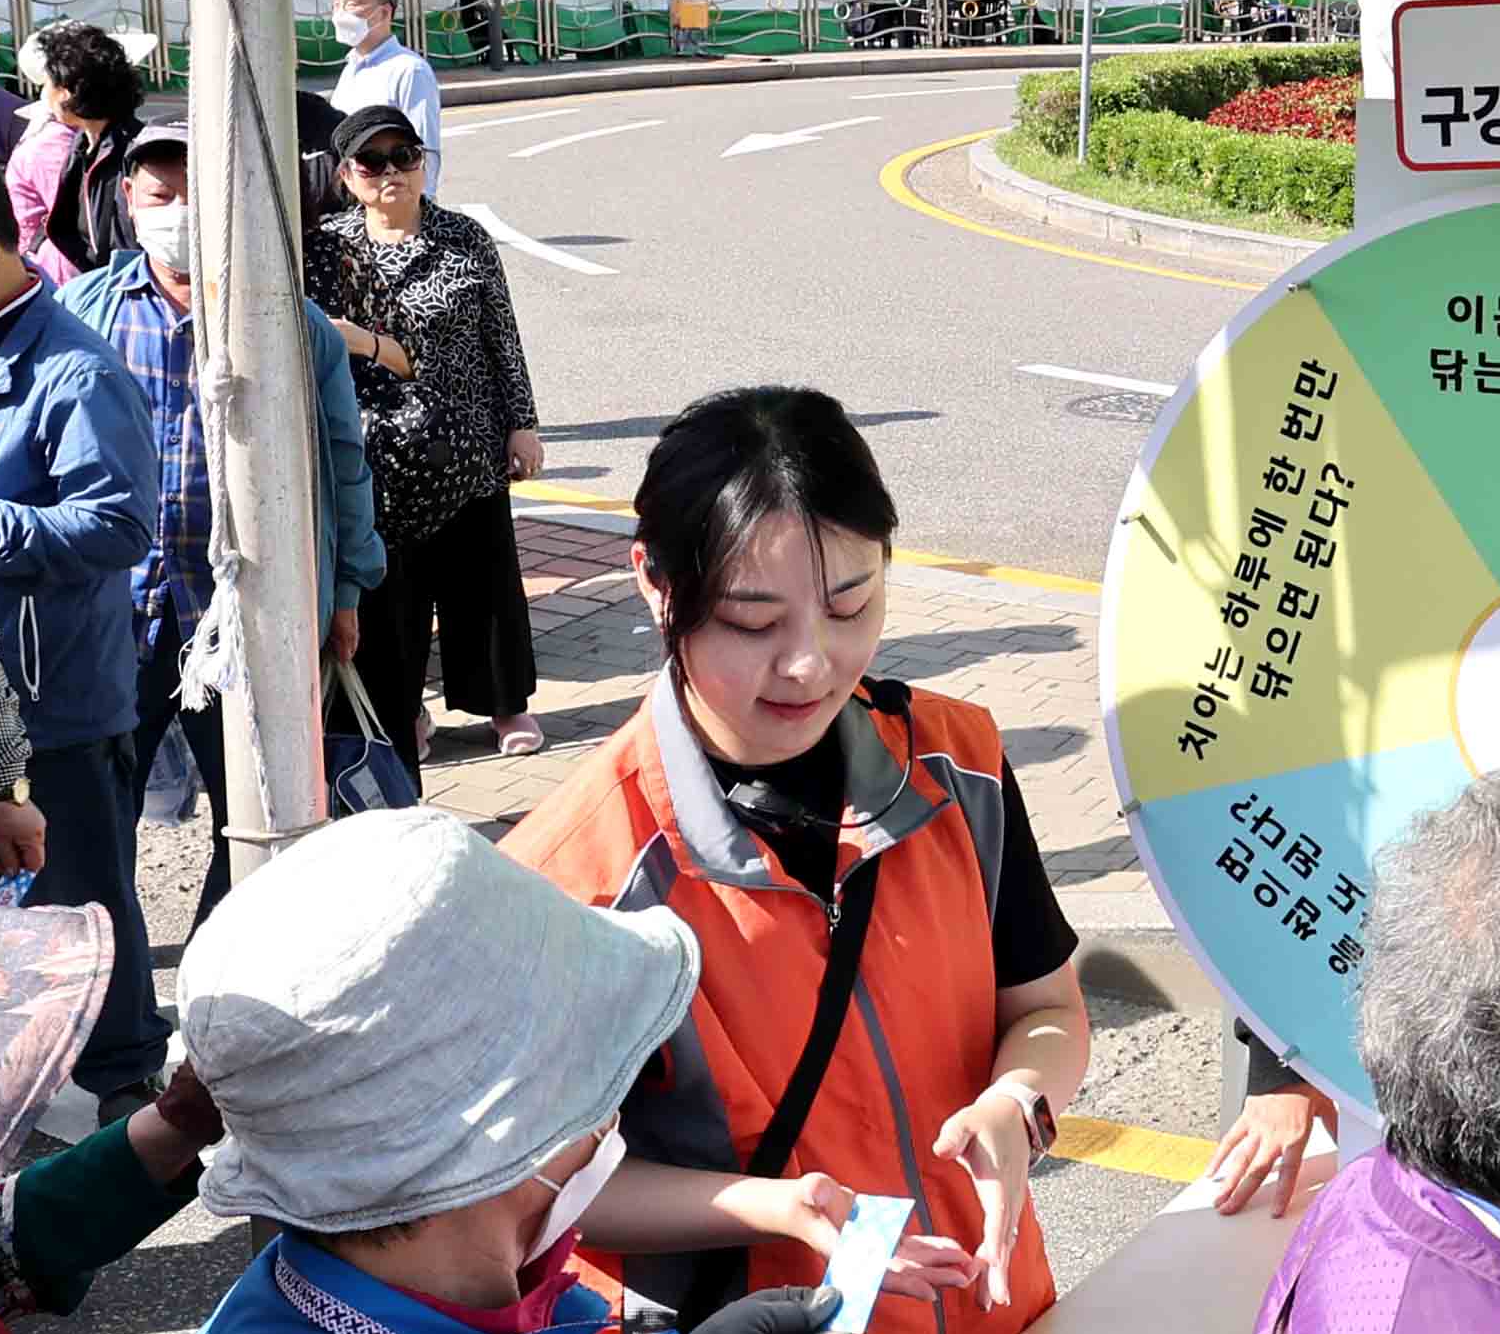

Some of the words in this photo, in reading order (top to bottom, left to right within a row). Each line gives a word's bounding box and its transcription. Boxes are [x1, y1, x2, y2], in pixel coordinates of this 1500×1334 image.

[1278, 357, 1338, 443] 번만
[1260, 455, 1308, 501] 한
[1219, 508, 1289, 632] 하루에
[1249, 583, 1319, 702] 닦으면
[1293, 460, 1356, 572] 된다?
[1177, 646, 1246, 762] 치아는
[1214, 836, 1321, 941] 씹으면
[1228, 793, 1322, 880] 된다?
